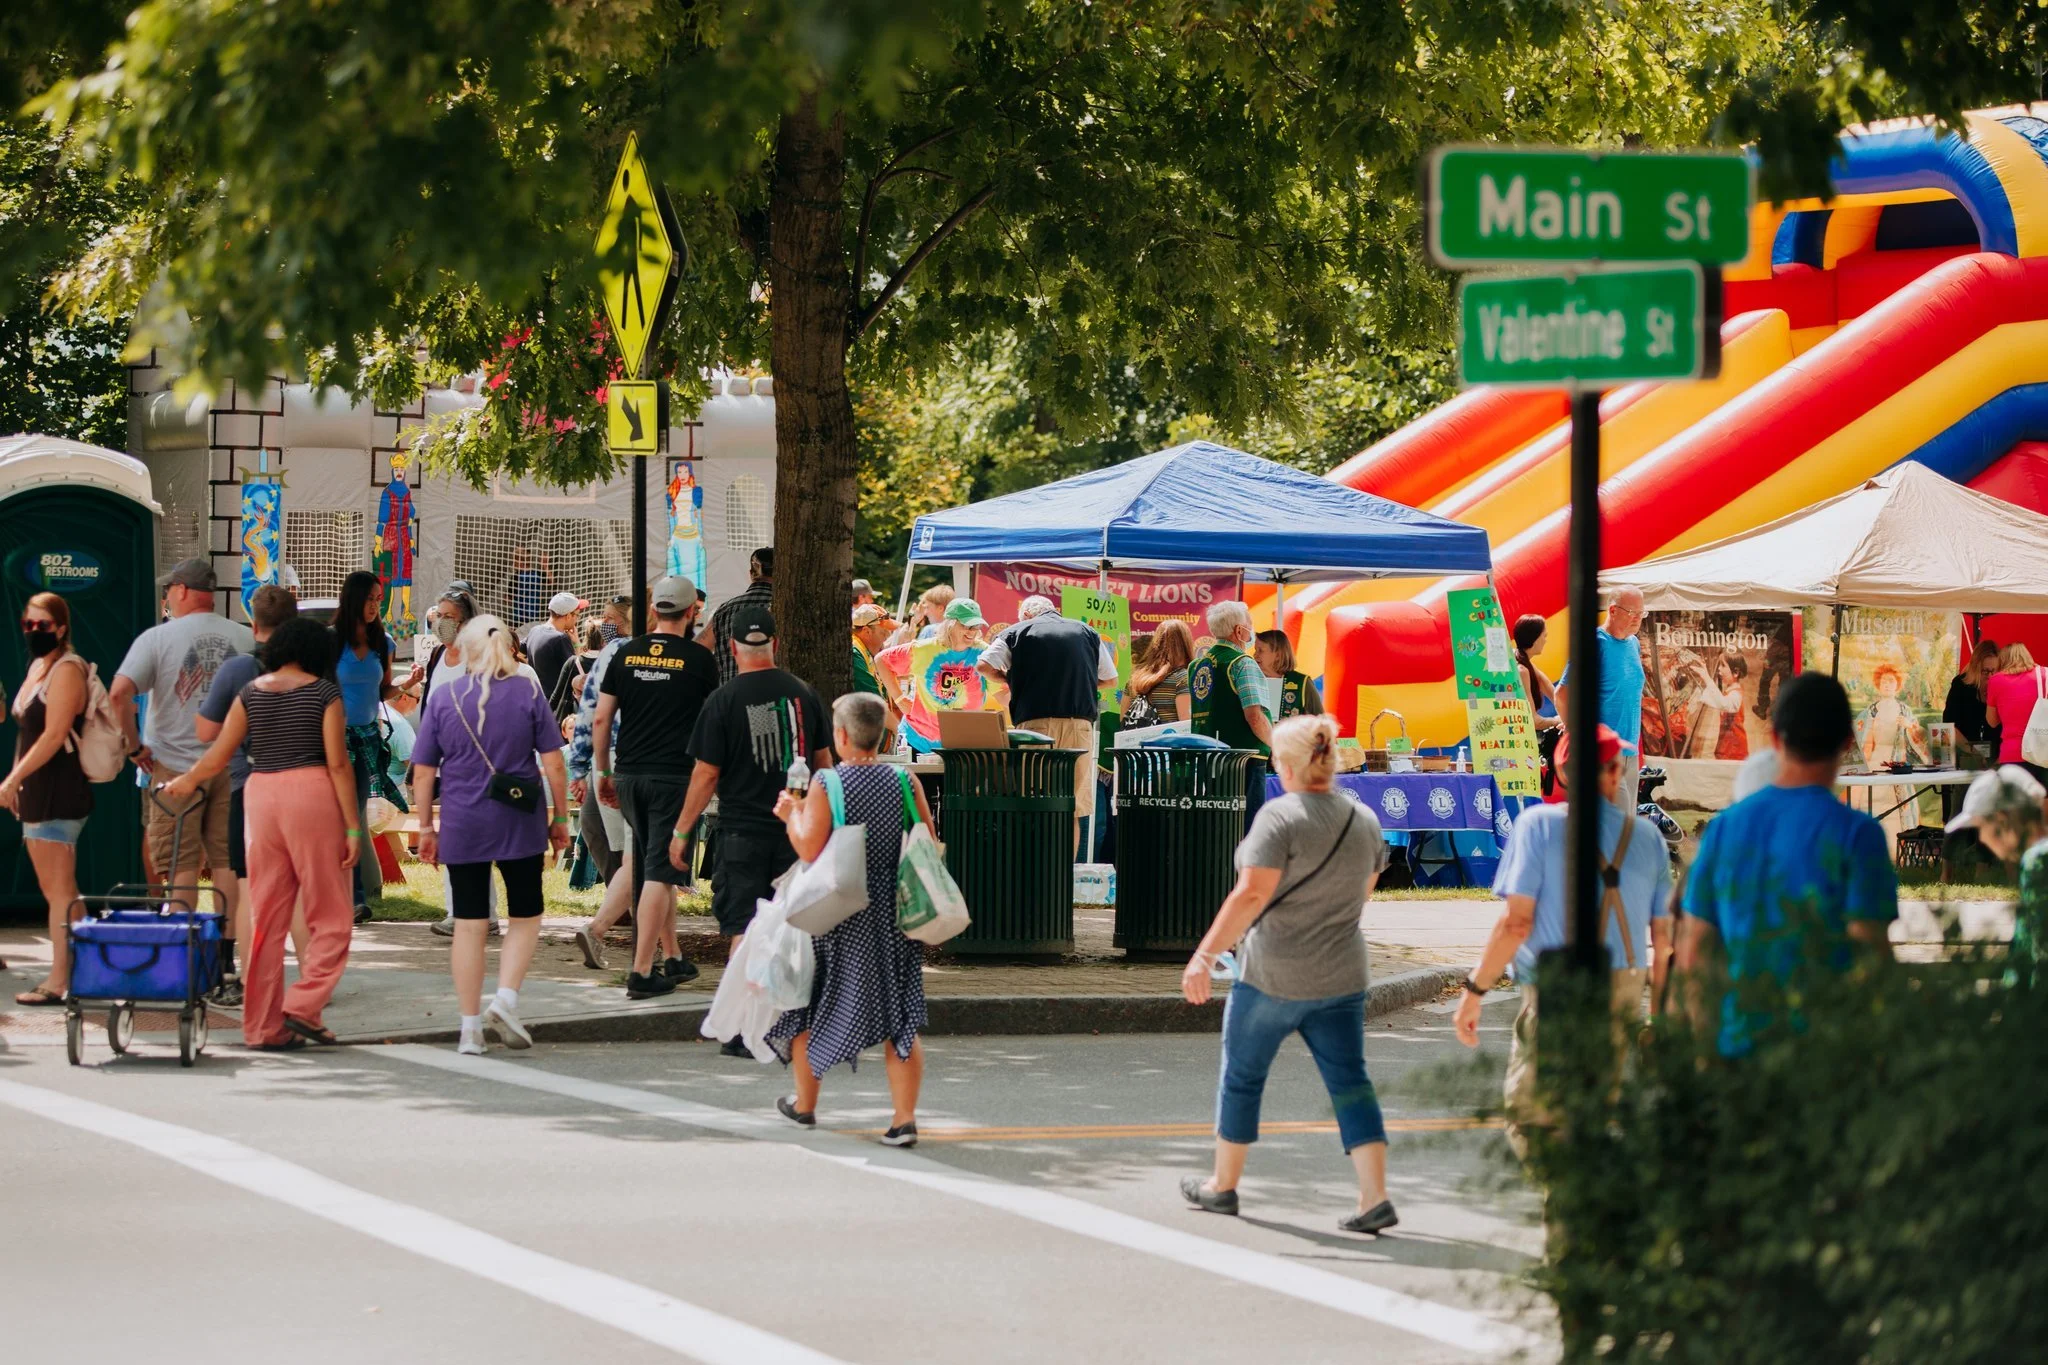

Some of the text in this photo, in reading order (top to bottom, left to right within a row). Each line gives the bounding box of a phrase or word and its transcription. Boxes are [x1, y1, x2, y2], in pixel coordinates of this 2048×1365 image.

[1478, 174, 1711, 241] Main St
[1477, 297, 1675, 364] Valentine St
[41, 554, 73, 566] 802
[45, 566, 99, 577] RESTROOMS
[1138, 582, 1214, 604] LIONS
[1086, 597, 1116, 613] 50/50
[1132, 611, 1200, 626] Community
[1840, 610, 1925, 634] Museum
[1655, 622, 1768, 653] Bennington
[624, 655, 685, 669] FINISHER
[633, 669, 671, 681] Rakuten
[941, 671, 970, 689] GARLIC
[1480, 740, 1521, 750] HEATING
[1139, 797, 1177, 807] RECYCLE
[1195, 800, 1230, 809] RECYCLE
